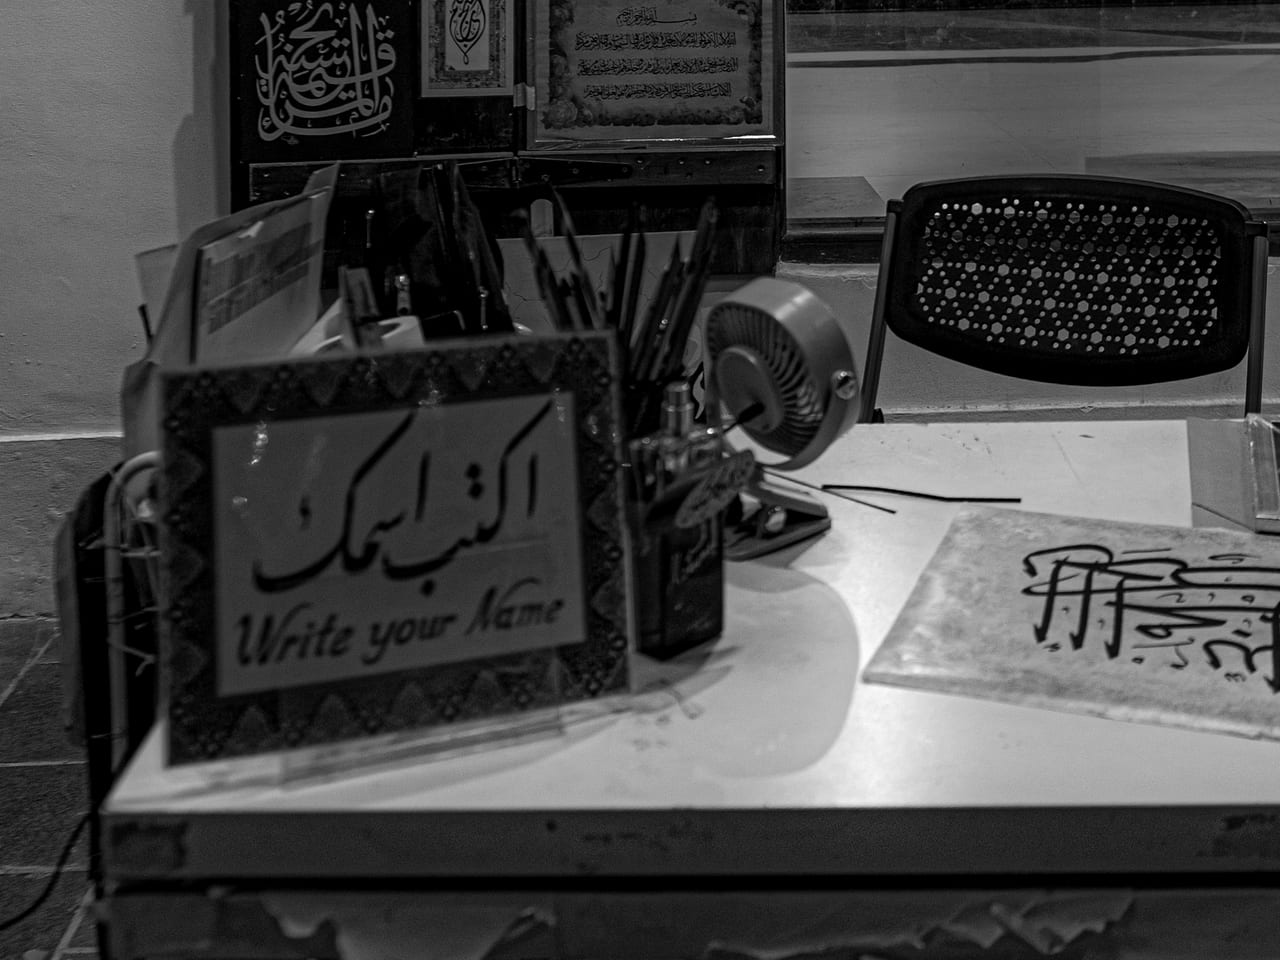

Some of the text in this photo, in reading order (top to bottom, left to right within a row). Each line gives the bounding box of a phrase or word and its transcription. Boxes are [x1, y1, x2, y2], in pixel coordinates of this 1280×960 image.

[253, 413, 430, 592] اسمك
[383, 400, 552, 597] اكتب
[236, 577, 565, 666] Write your Name
